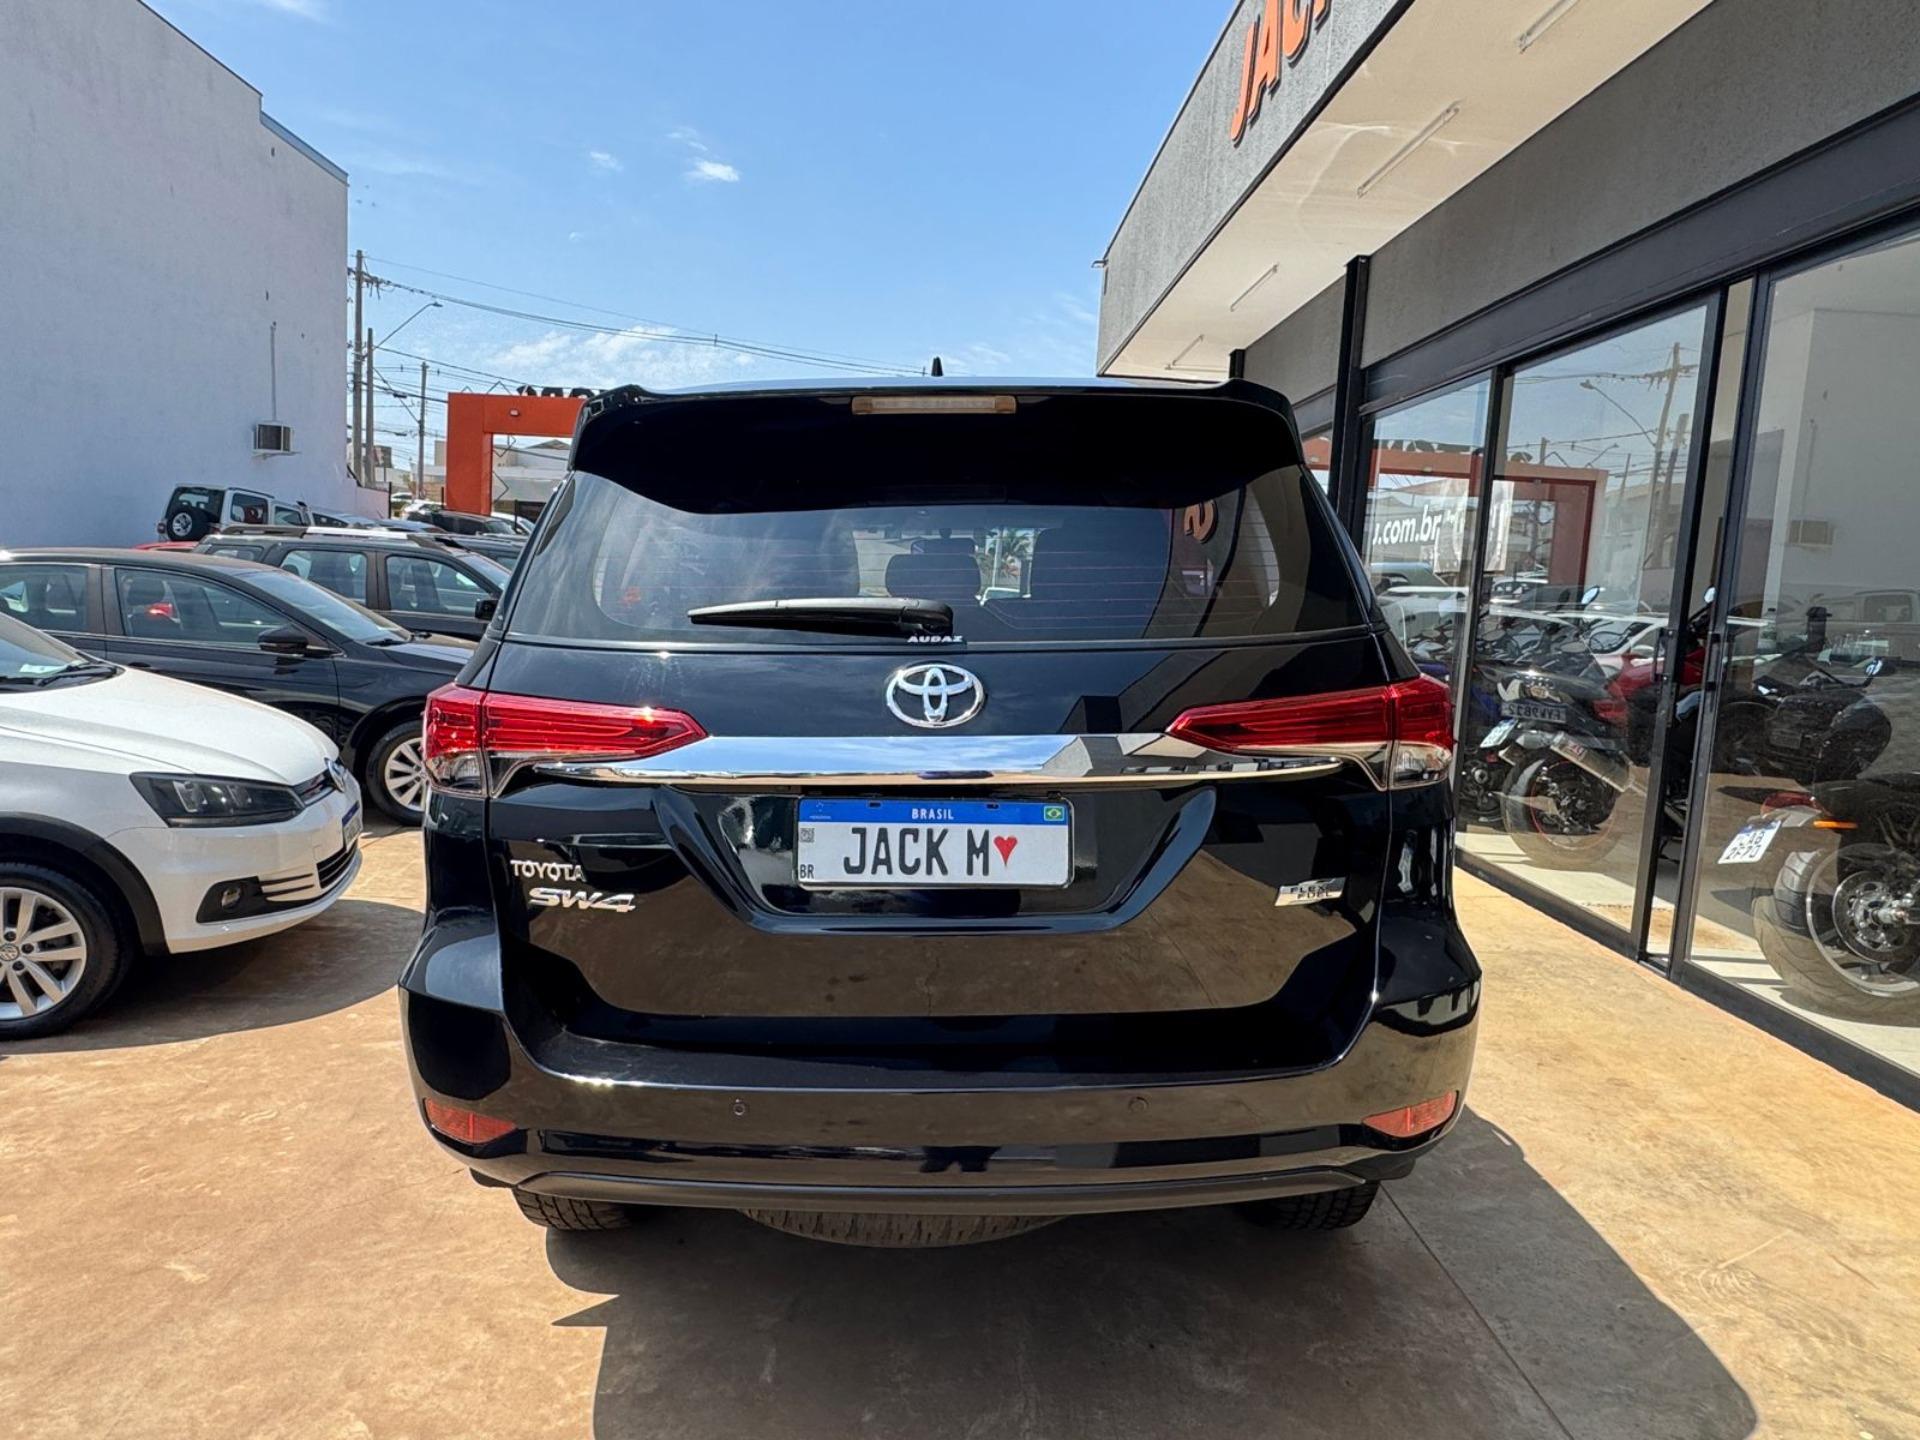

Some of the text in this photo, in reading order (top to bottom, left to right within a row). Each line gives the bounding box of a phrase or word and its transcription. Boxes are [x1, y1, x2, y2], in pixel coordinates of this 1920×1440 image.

[907, 635, 963, 643] AUDAZ
[911, 807, 954, 821] BRASIL
[843, 827, 949, 876] JACK
[510, 859, 587, 882] TOYOTA
[800, 864, 815, 879] BR
[529, 887, 636, 913] SW4
